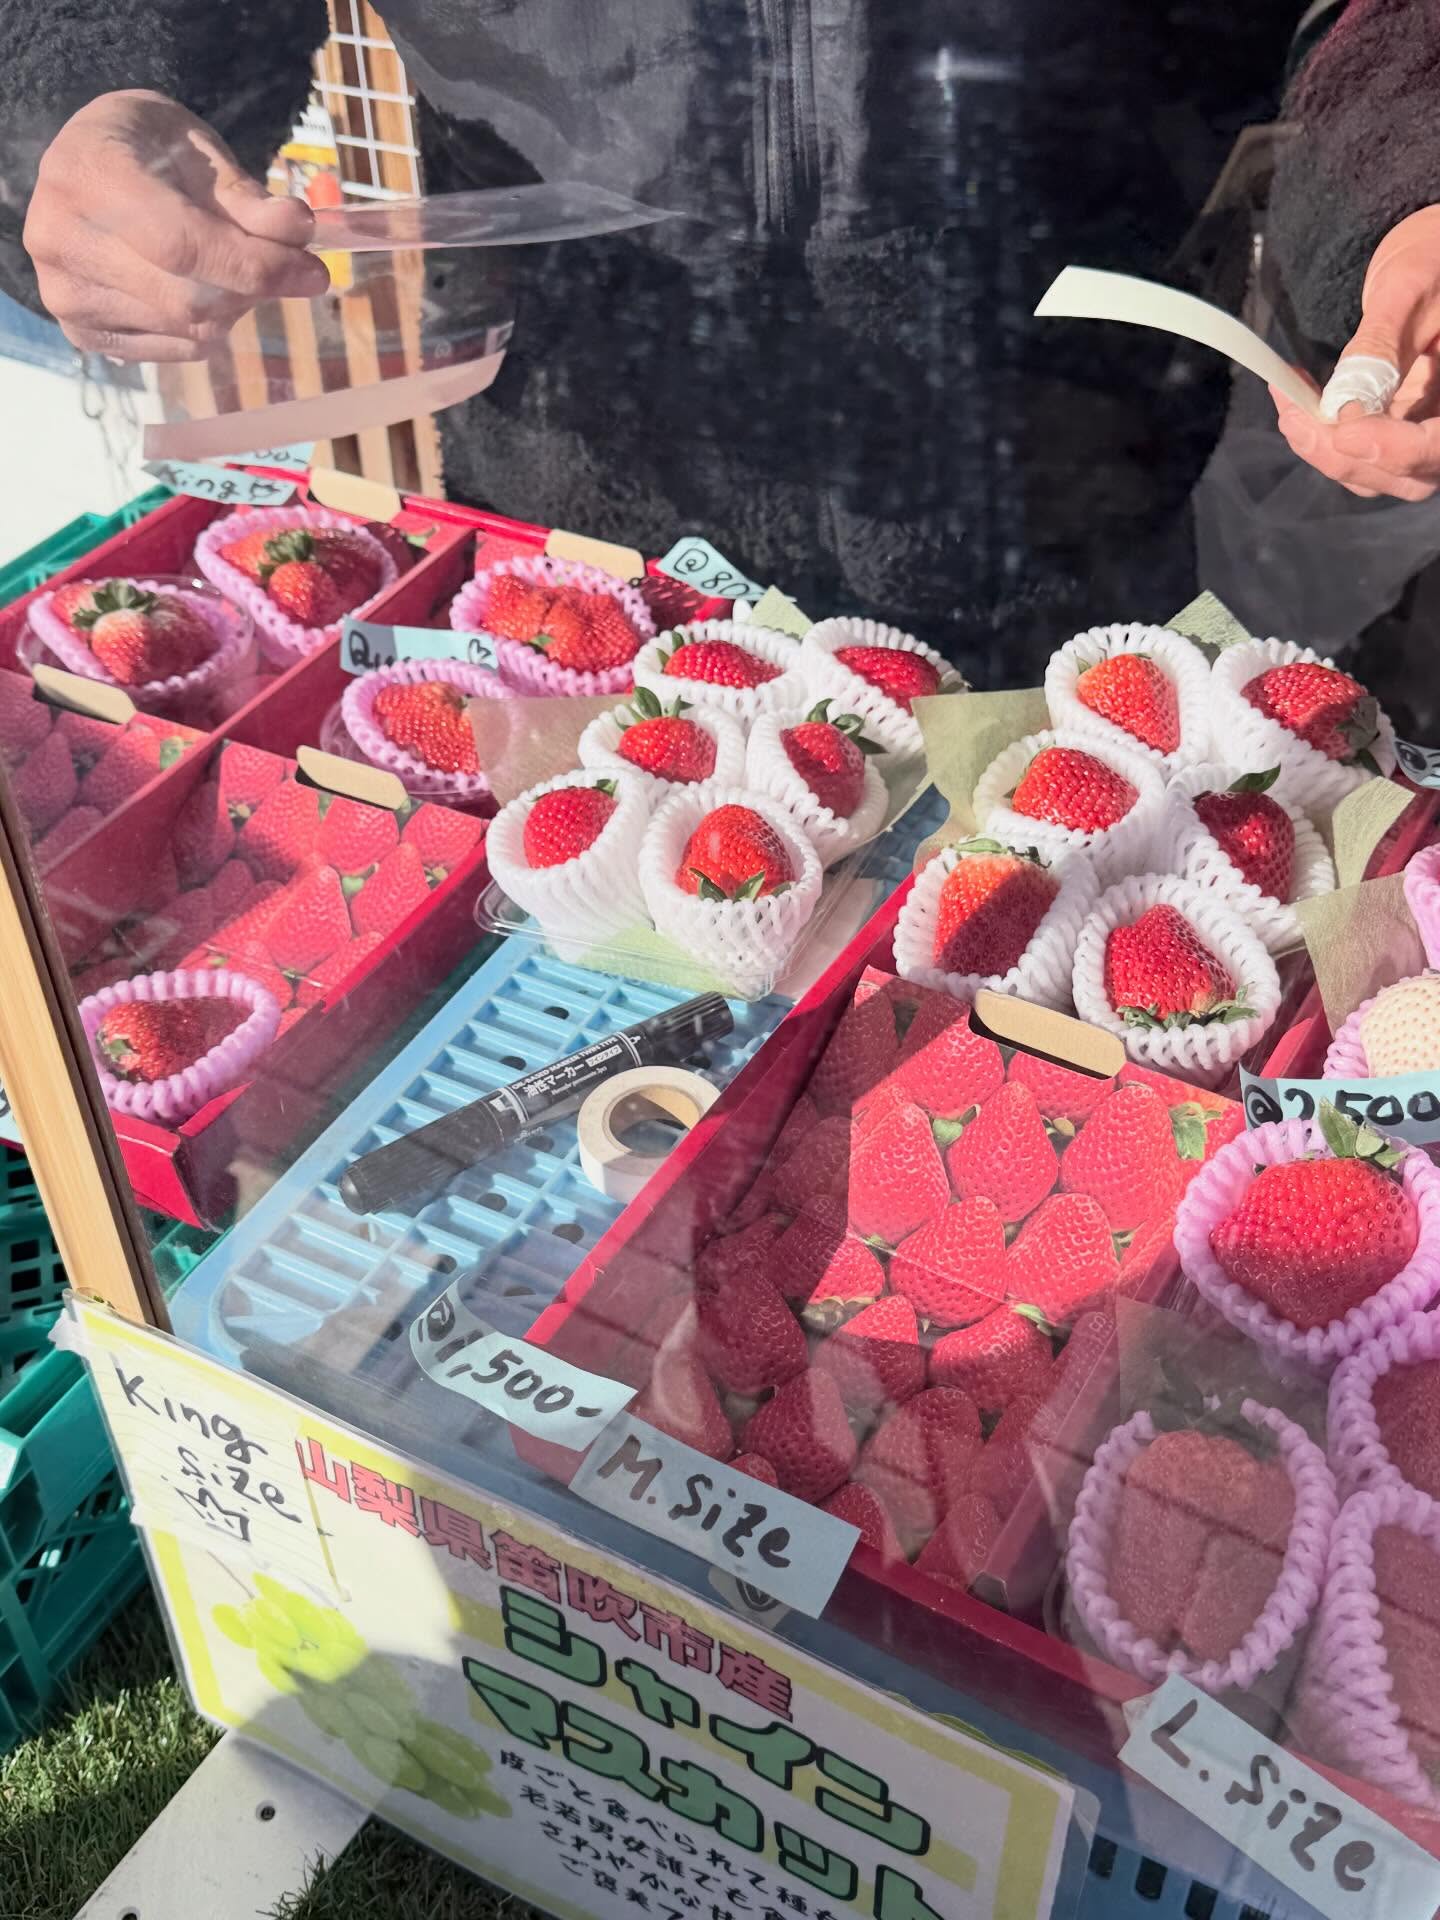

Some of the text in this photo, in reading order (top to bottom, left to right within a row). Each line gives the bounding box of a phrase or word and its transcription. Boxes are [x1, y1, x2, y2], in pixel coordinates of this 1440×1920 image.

[674, 548, 765, 597] @80
[522, 1063, 585, 1099] 油性マーカー
[110, 1352, 268, 1465] King
[295, 1436, 793, 1723] 山梨県笛吹市産
[500, 1585, 931, 1856] シャイン
[1151, 1698, 1210, 1783] L.
[461, 1656, 946, 1920] マスカット
